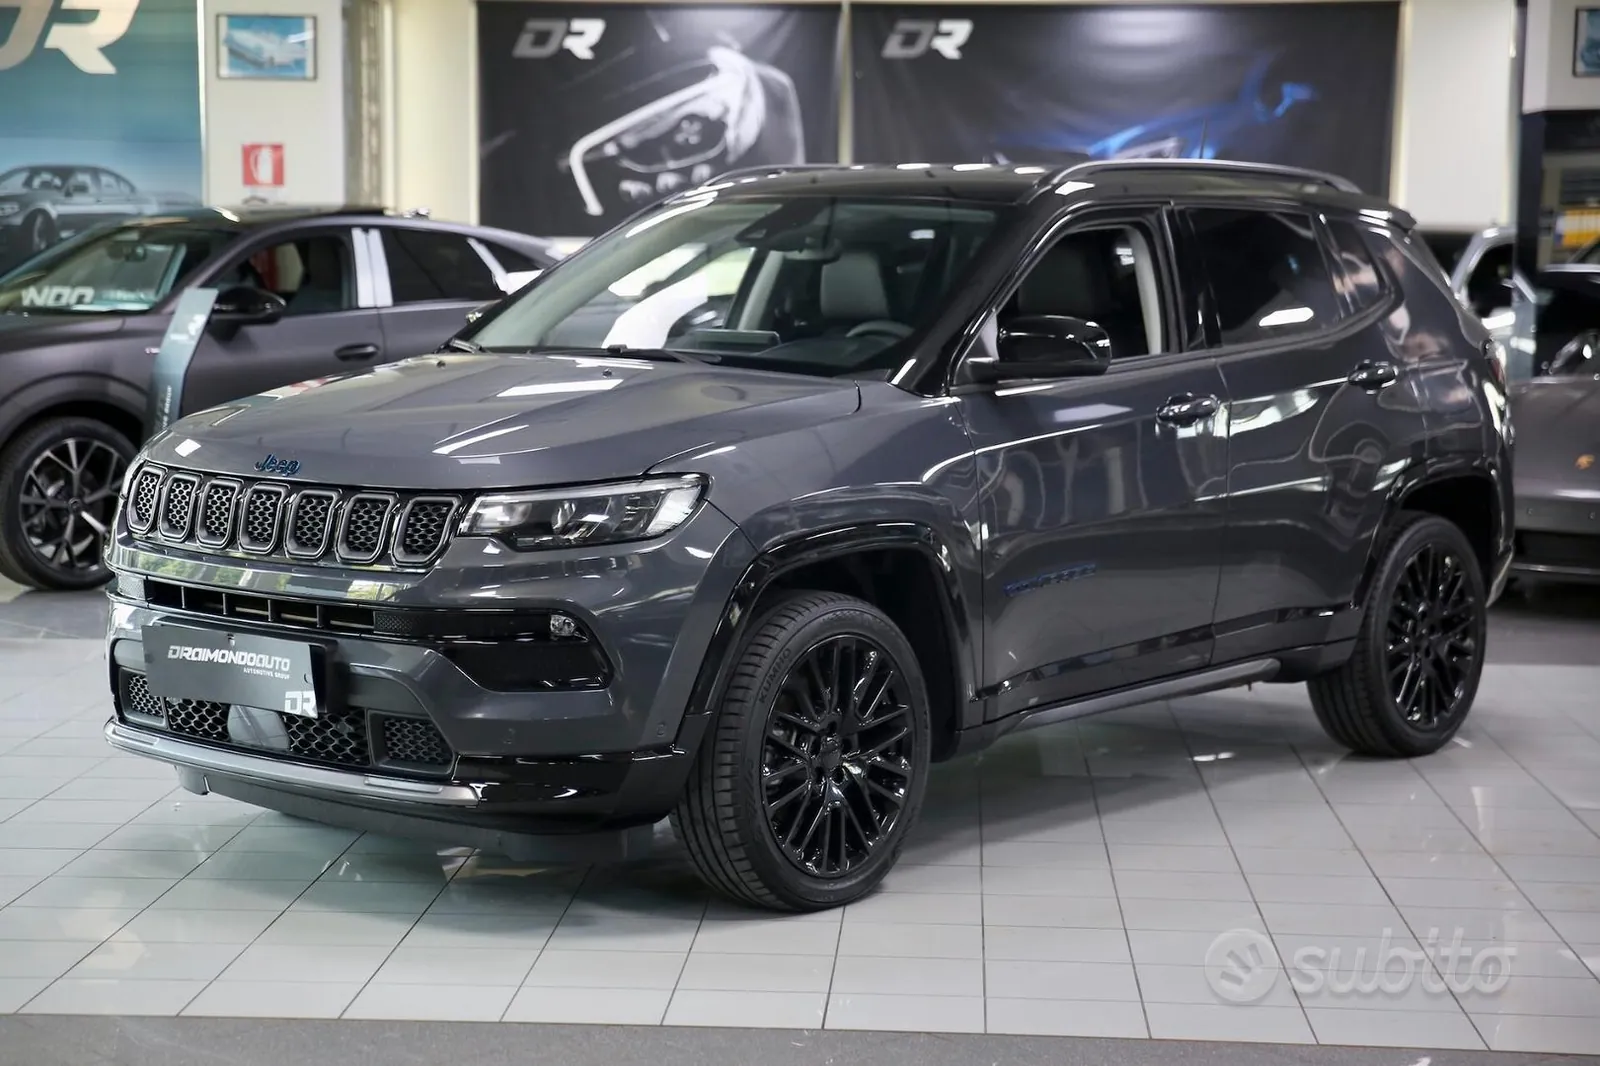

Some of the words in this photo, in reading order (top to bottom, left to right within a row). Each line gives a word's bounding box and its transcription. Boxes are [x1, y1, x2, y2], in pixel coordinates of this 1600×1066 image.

[512, 18, 607, 60] DR
[881, 18, 974, 60] DR
[253, 453, 300, 478] Jeep
[274, 672, 290, 680] GROUP
[760, 648, 793, 703] KUMHO
[284, 690, 319, 719] DR
